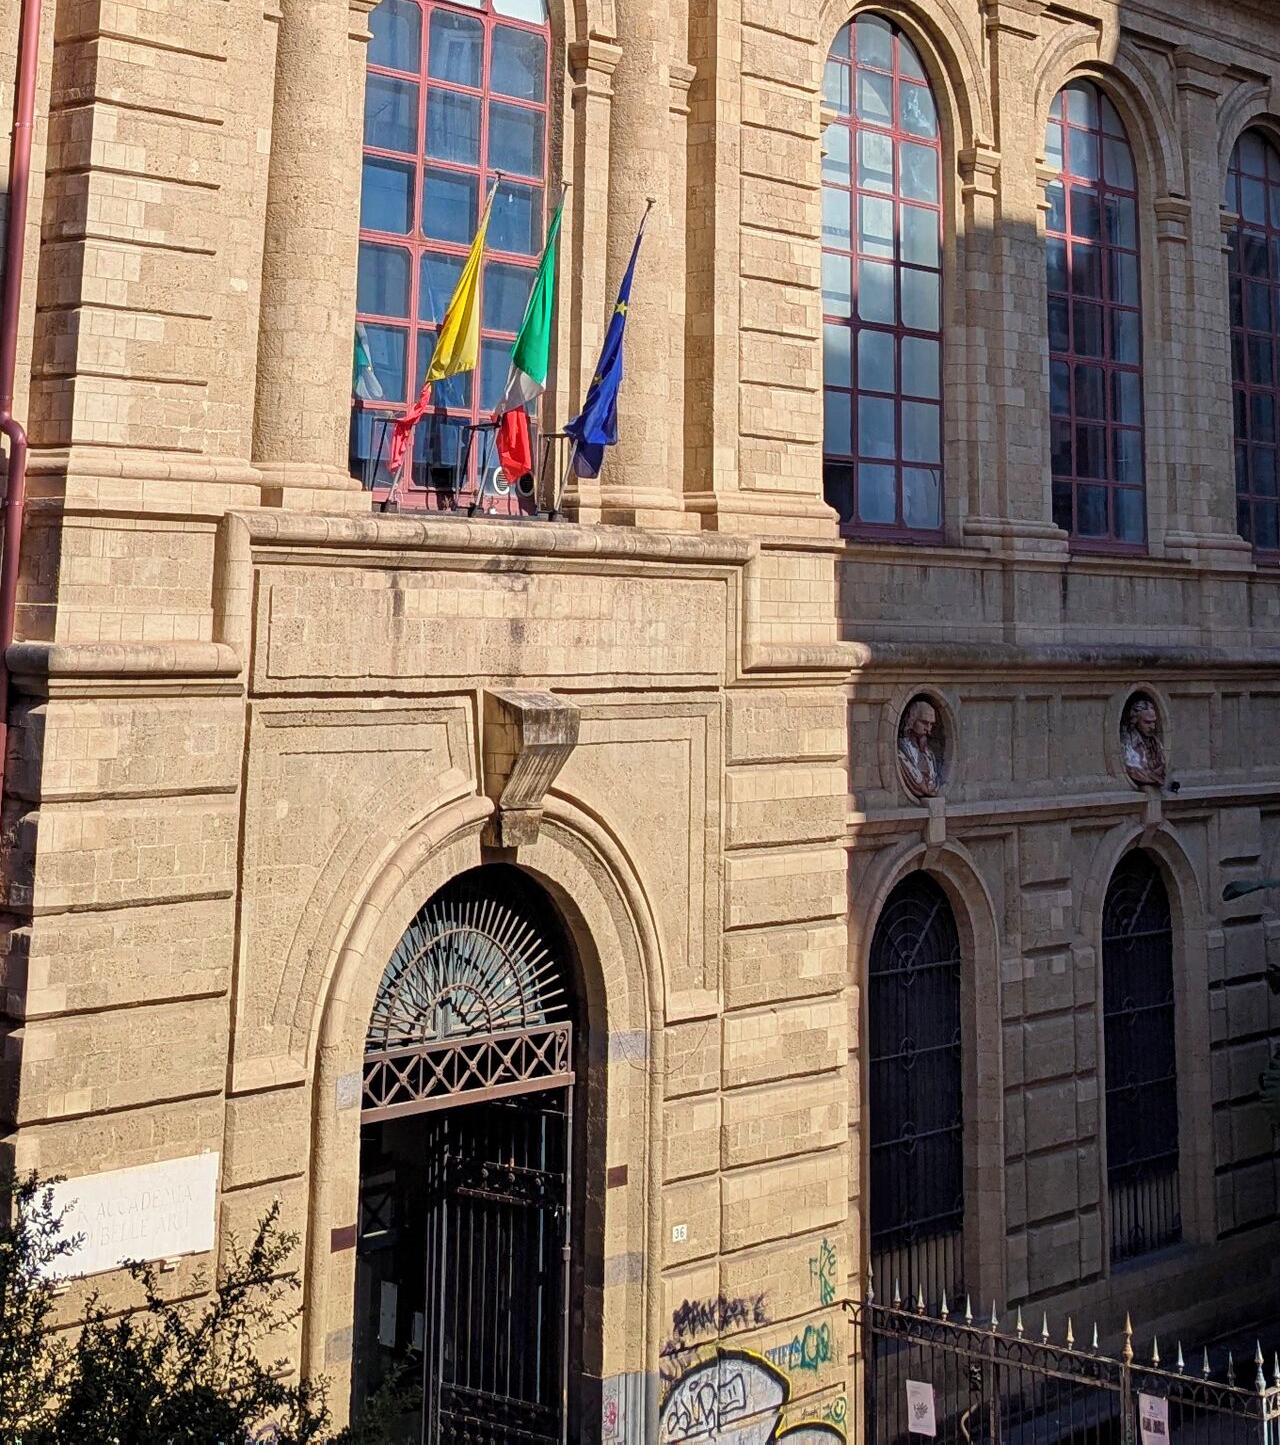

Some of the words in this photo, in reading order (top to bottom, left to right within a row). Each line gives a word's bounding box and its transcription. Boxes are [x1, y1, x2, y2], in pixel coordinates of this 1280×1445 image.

[97, 1185, 193, 1219] ACCADEMIA
[101, 1219, 149, 1246] BELLE
[674, 1225, 686, 1240] 36
